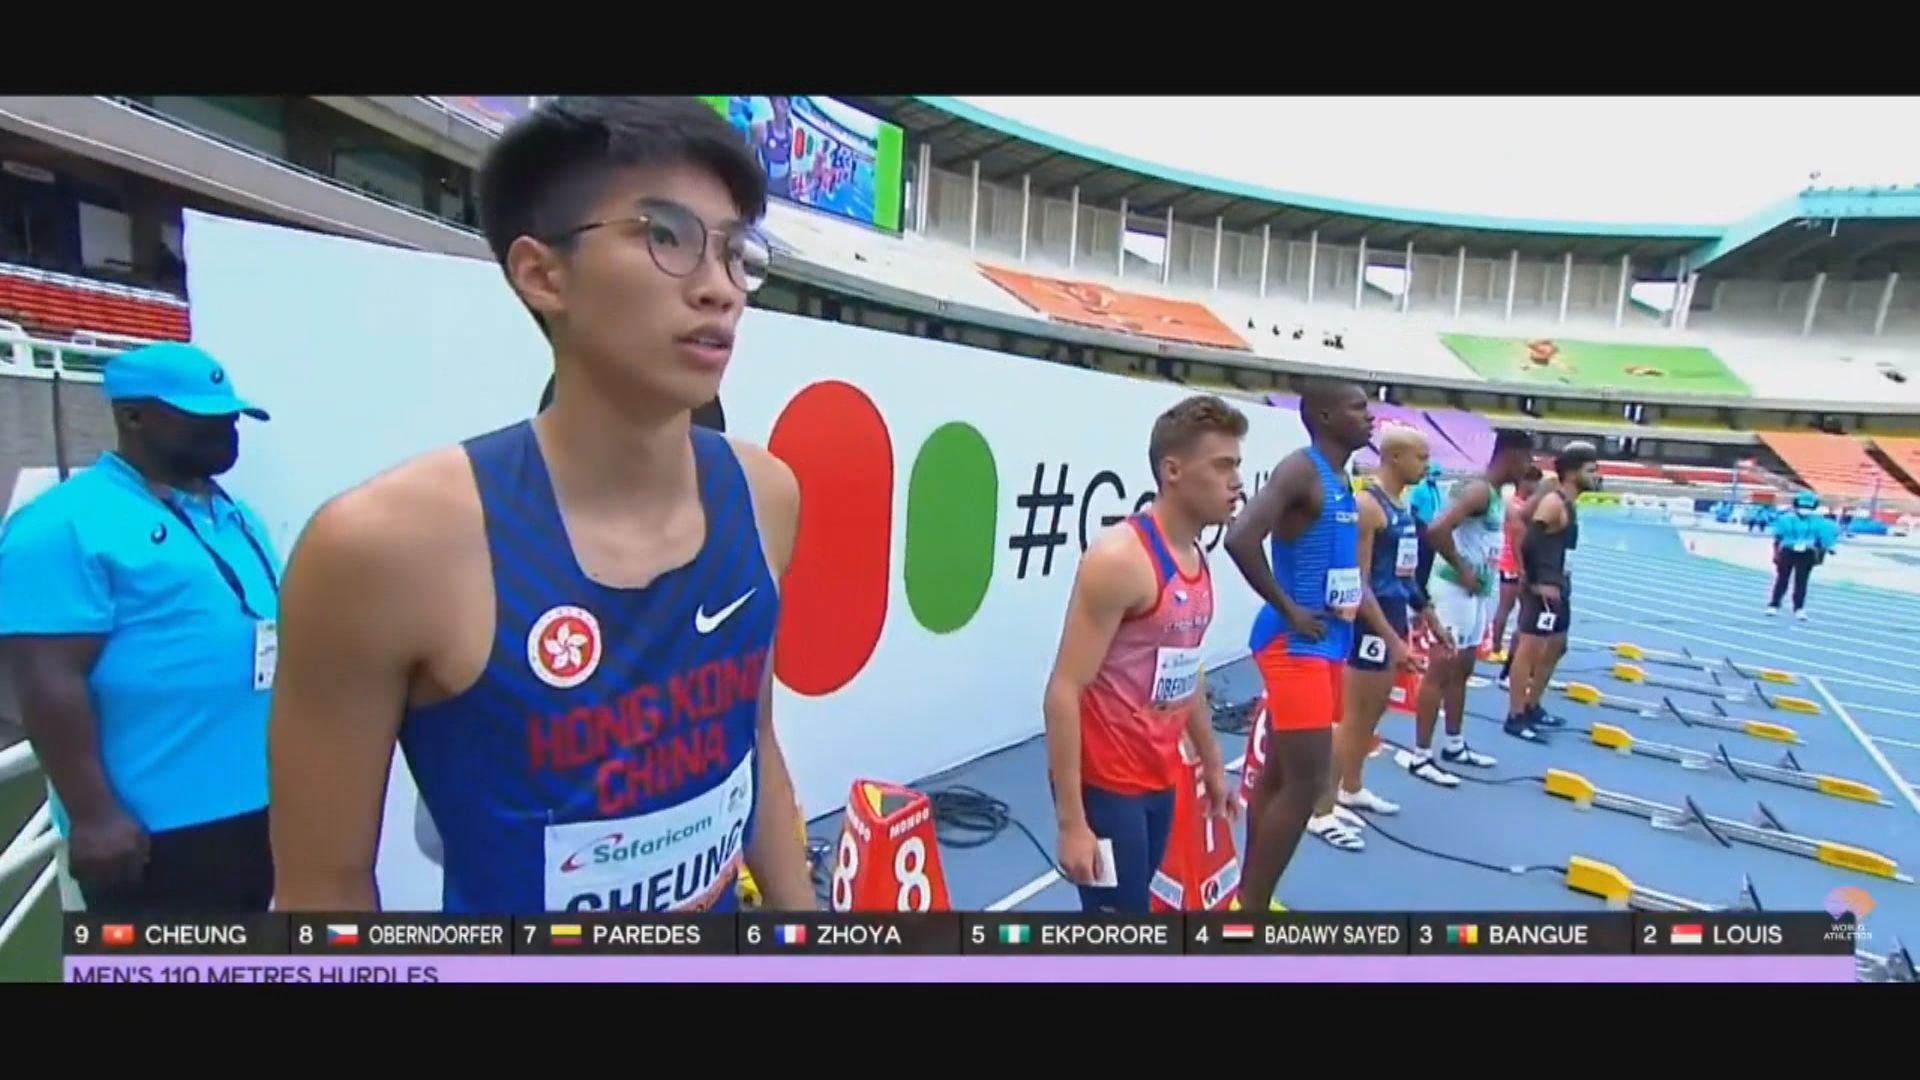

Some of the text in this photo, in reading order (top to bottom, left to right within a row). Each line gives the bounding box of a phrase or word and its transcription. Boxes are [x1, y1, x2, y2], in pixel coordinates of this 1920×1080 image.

[1366, 640, 1380, 657] 6
[530, 648, 766, 773] HONG KON
[597, 721, 728, 814] CHINA
[593, 815, 713, 865] Safaricom
[889, 807, 929, 841] MONDO
[832, 831, 859, 913] 8
[894, 836, 932, 913] 8
